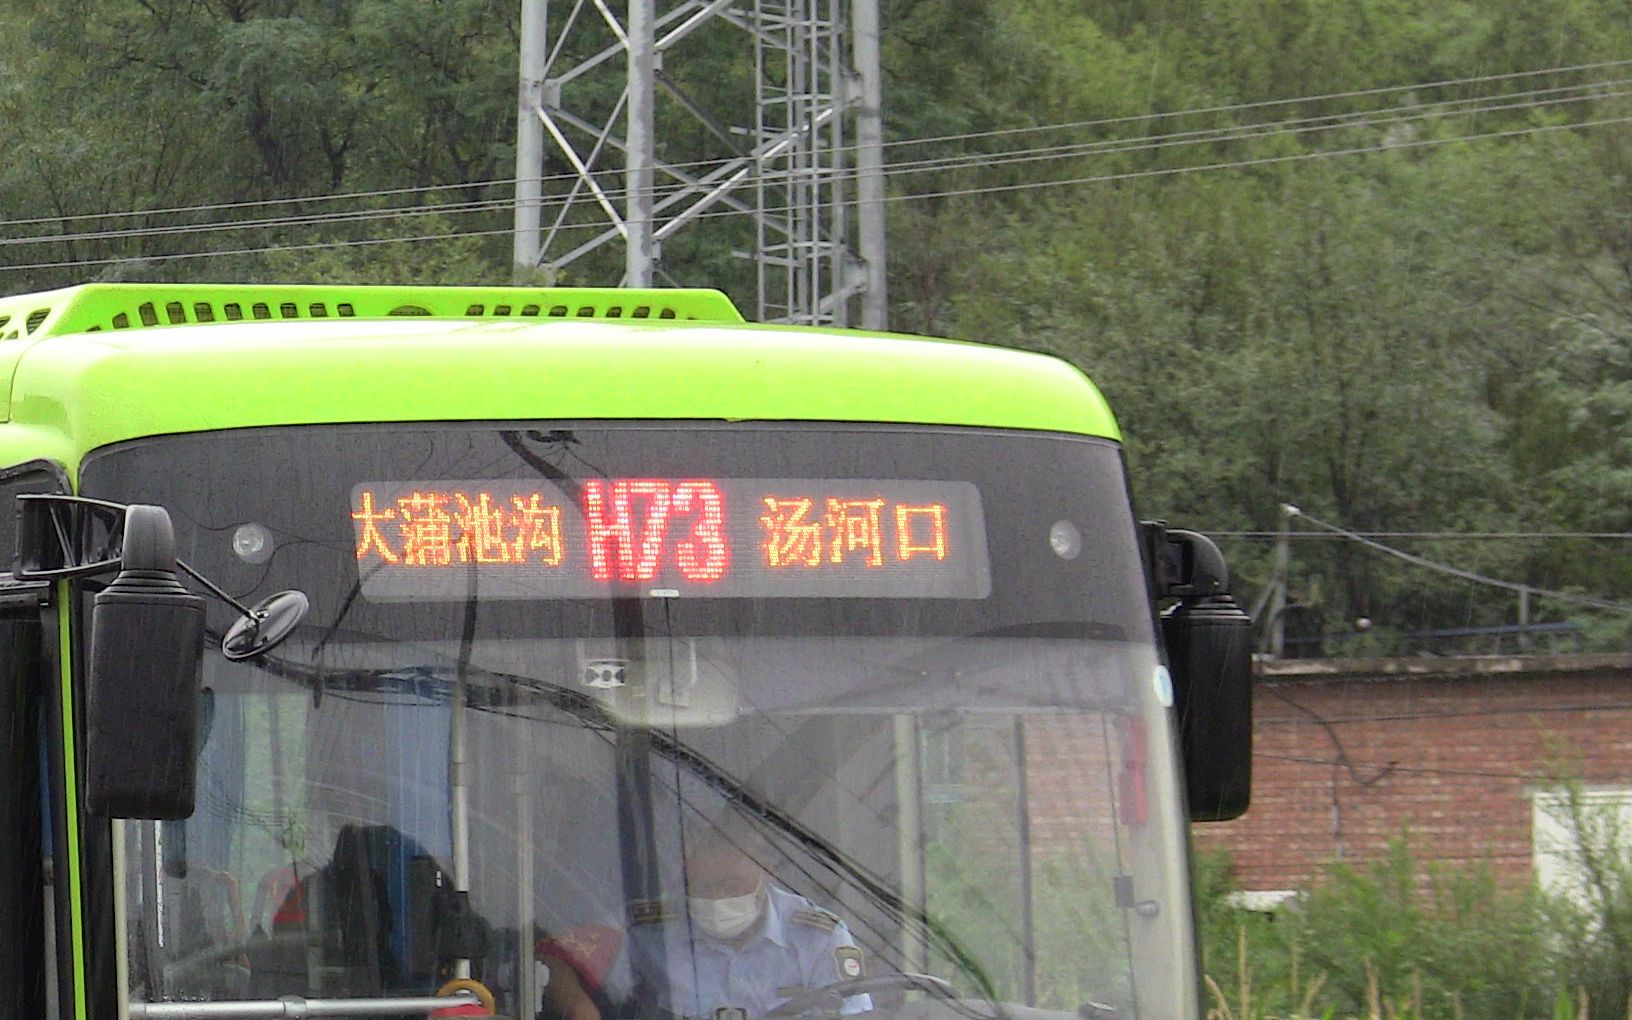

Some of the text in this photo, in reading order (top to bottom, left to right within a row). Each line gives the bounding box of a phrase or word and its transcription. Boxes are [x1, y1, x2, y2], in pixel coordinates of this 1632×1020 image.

[352, 480, 948, 581] 大蒲池沟 H73 汤河口
